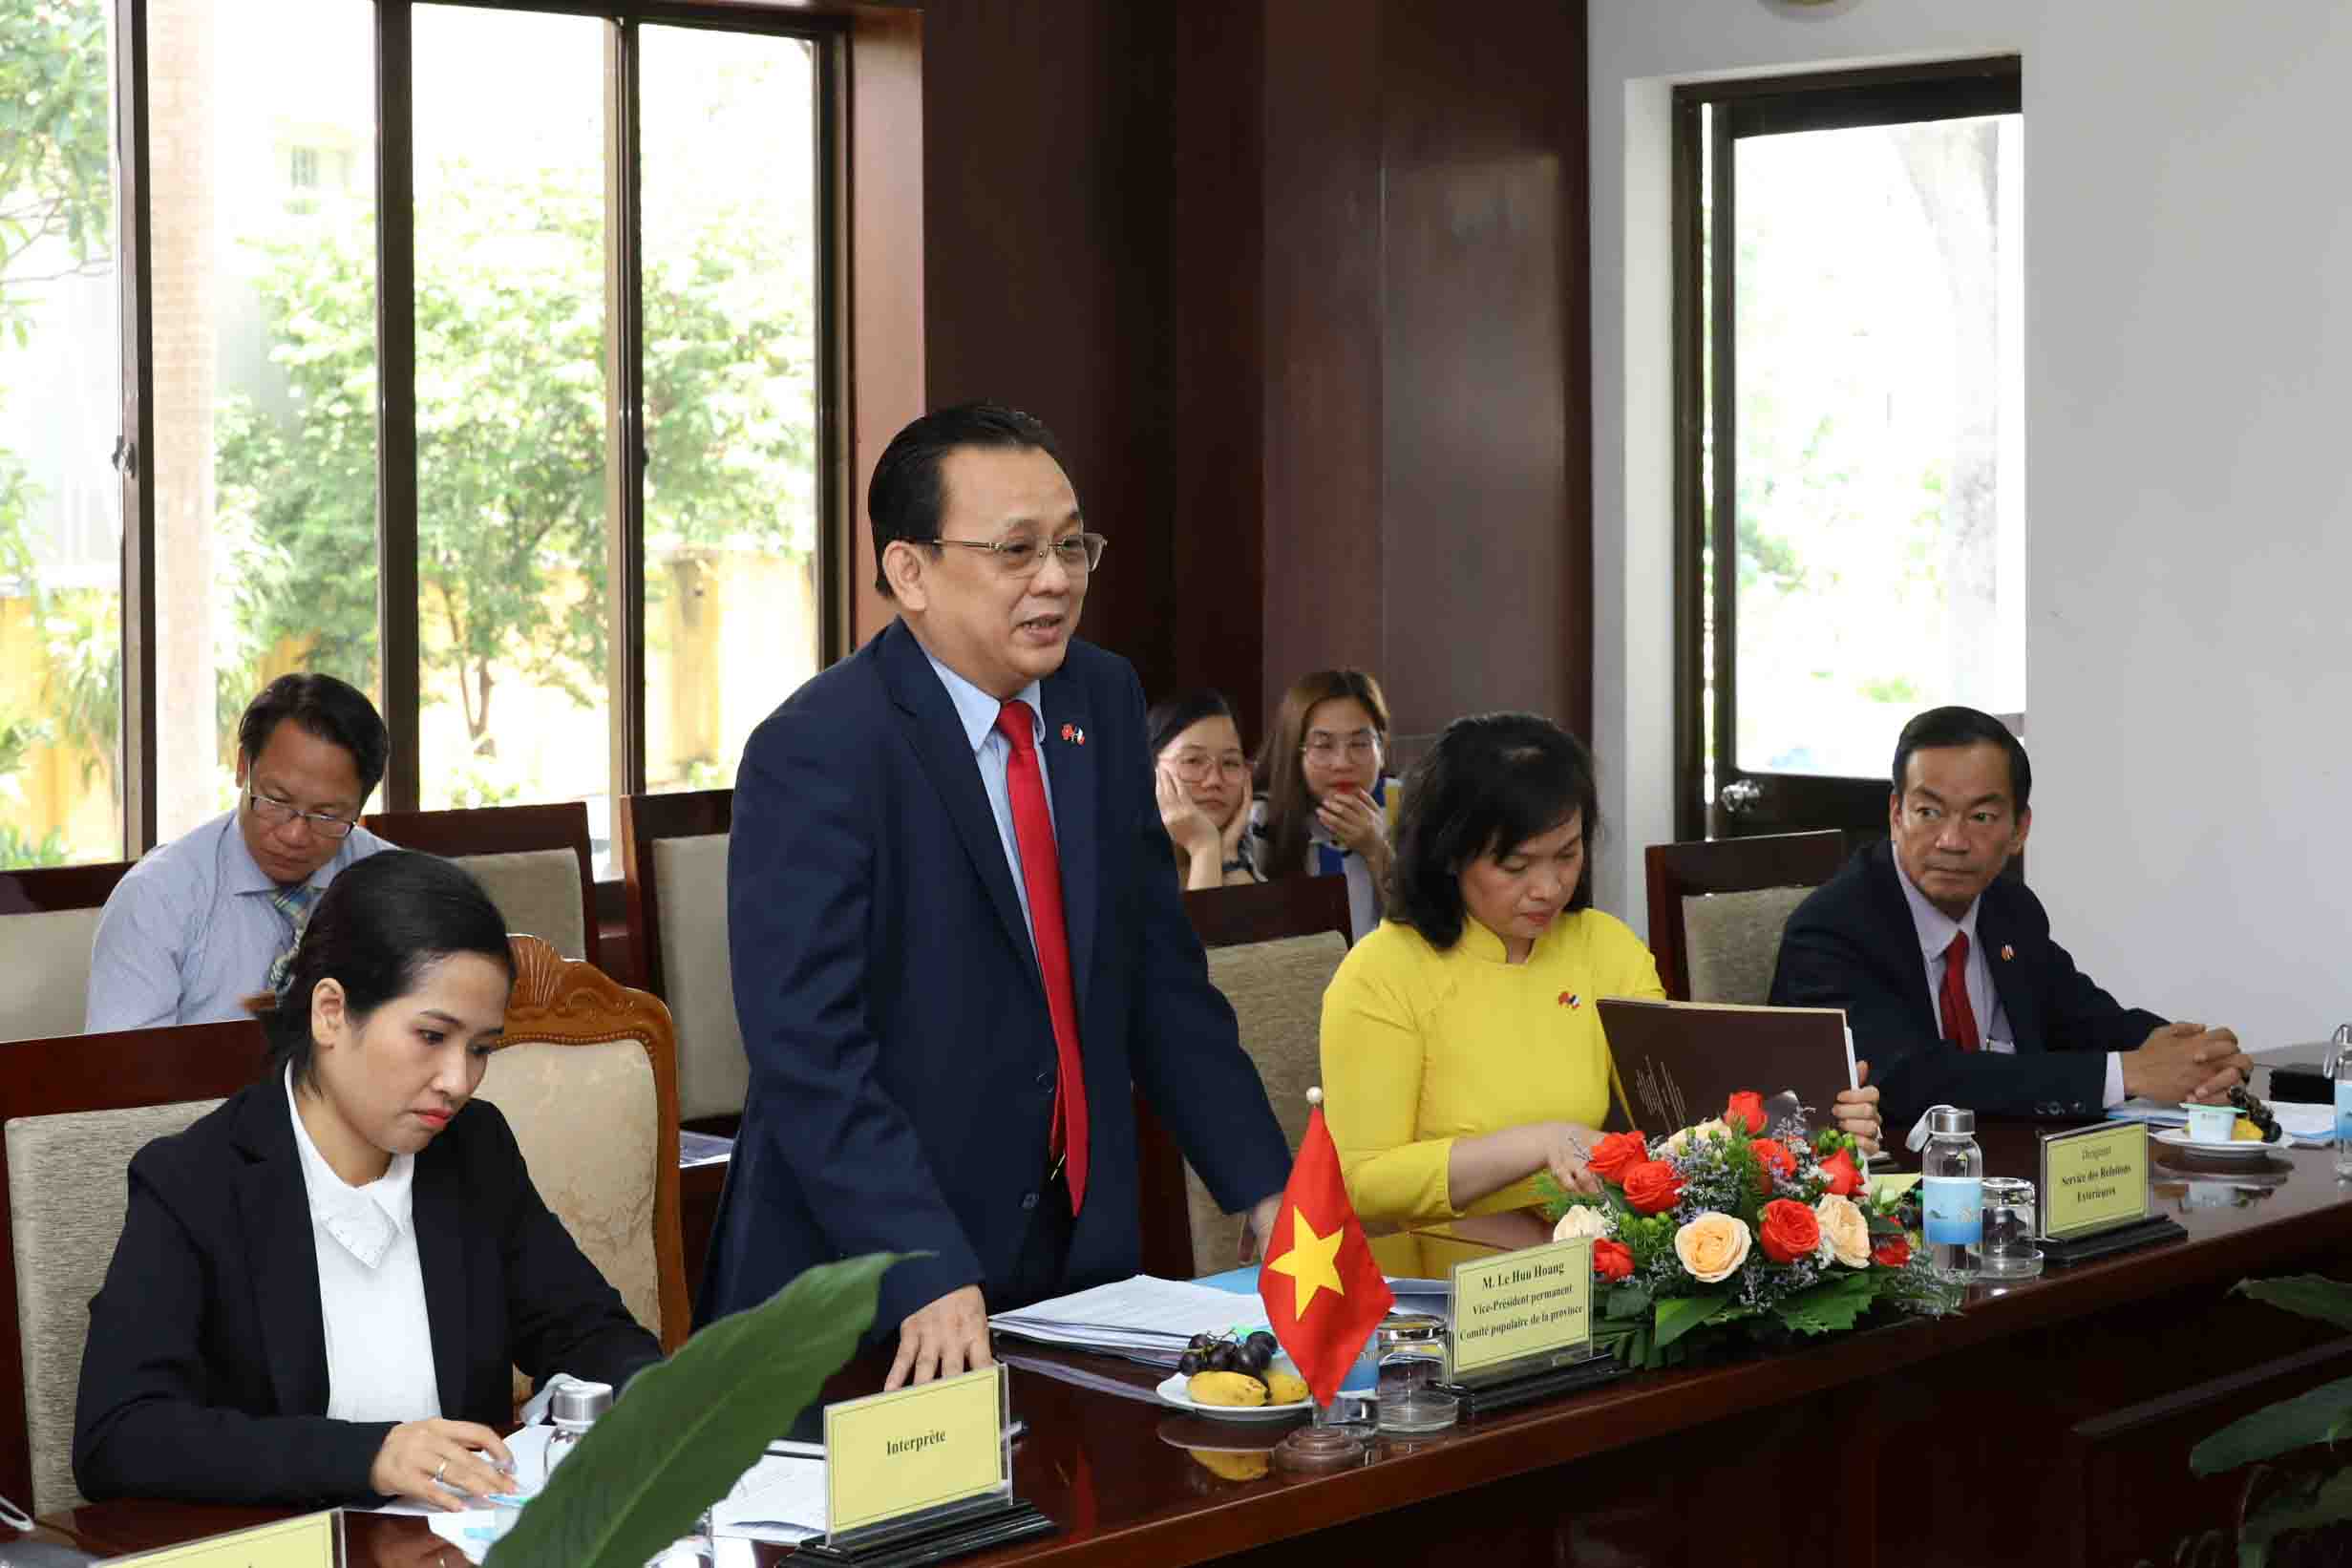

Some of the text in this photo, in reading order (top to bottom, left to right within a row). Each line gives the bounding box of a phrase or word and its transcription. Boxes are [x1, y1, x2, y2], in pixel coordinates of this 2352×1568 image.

[1482, 1276, 1495, 1290] M.
[1497, 1273, 1511, 1286] Le
[1534, 1262, 1565, 1278] Hoang
[1531, 1284, 1573, 1303] permanent
[1490, 1316, 1529, 1337] populaire
[1530, 1313, 1540, 1324] de
[1541, 1312, 1550, 1322] la
[1551, 1305, 1583, 1320] province
[886, 1430, 946, 1456] Interprète
